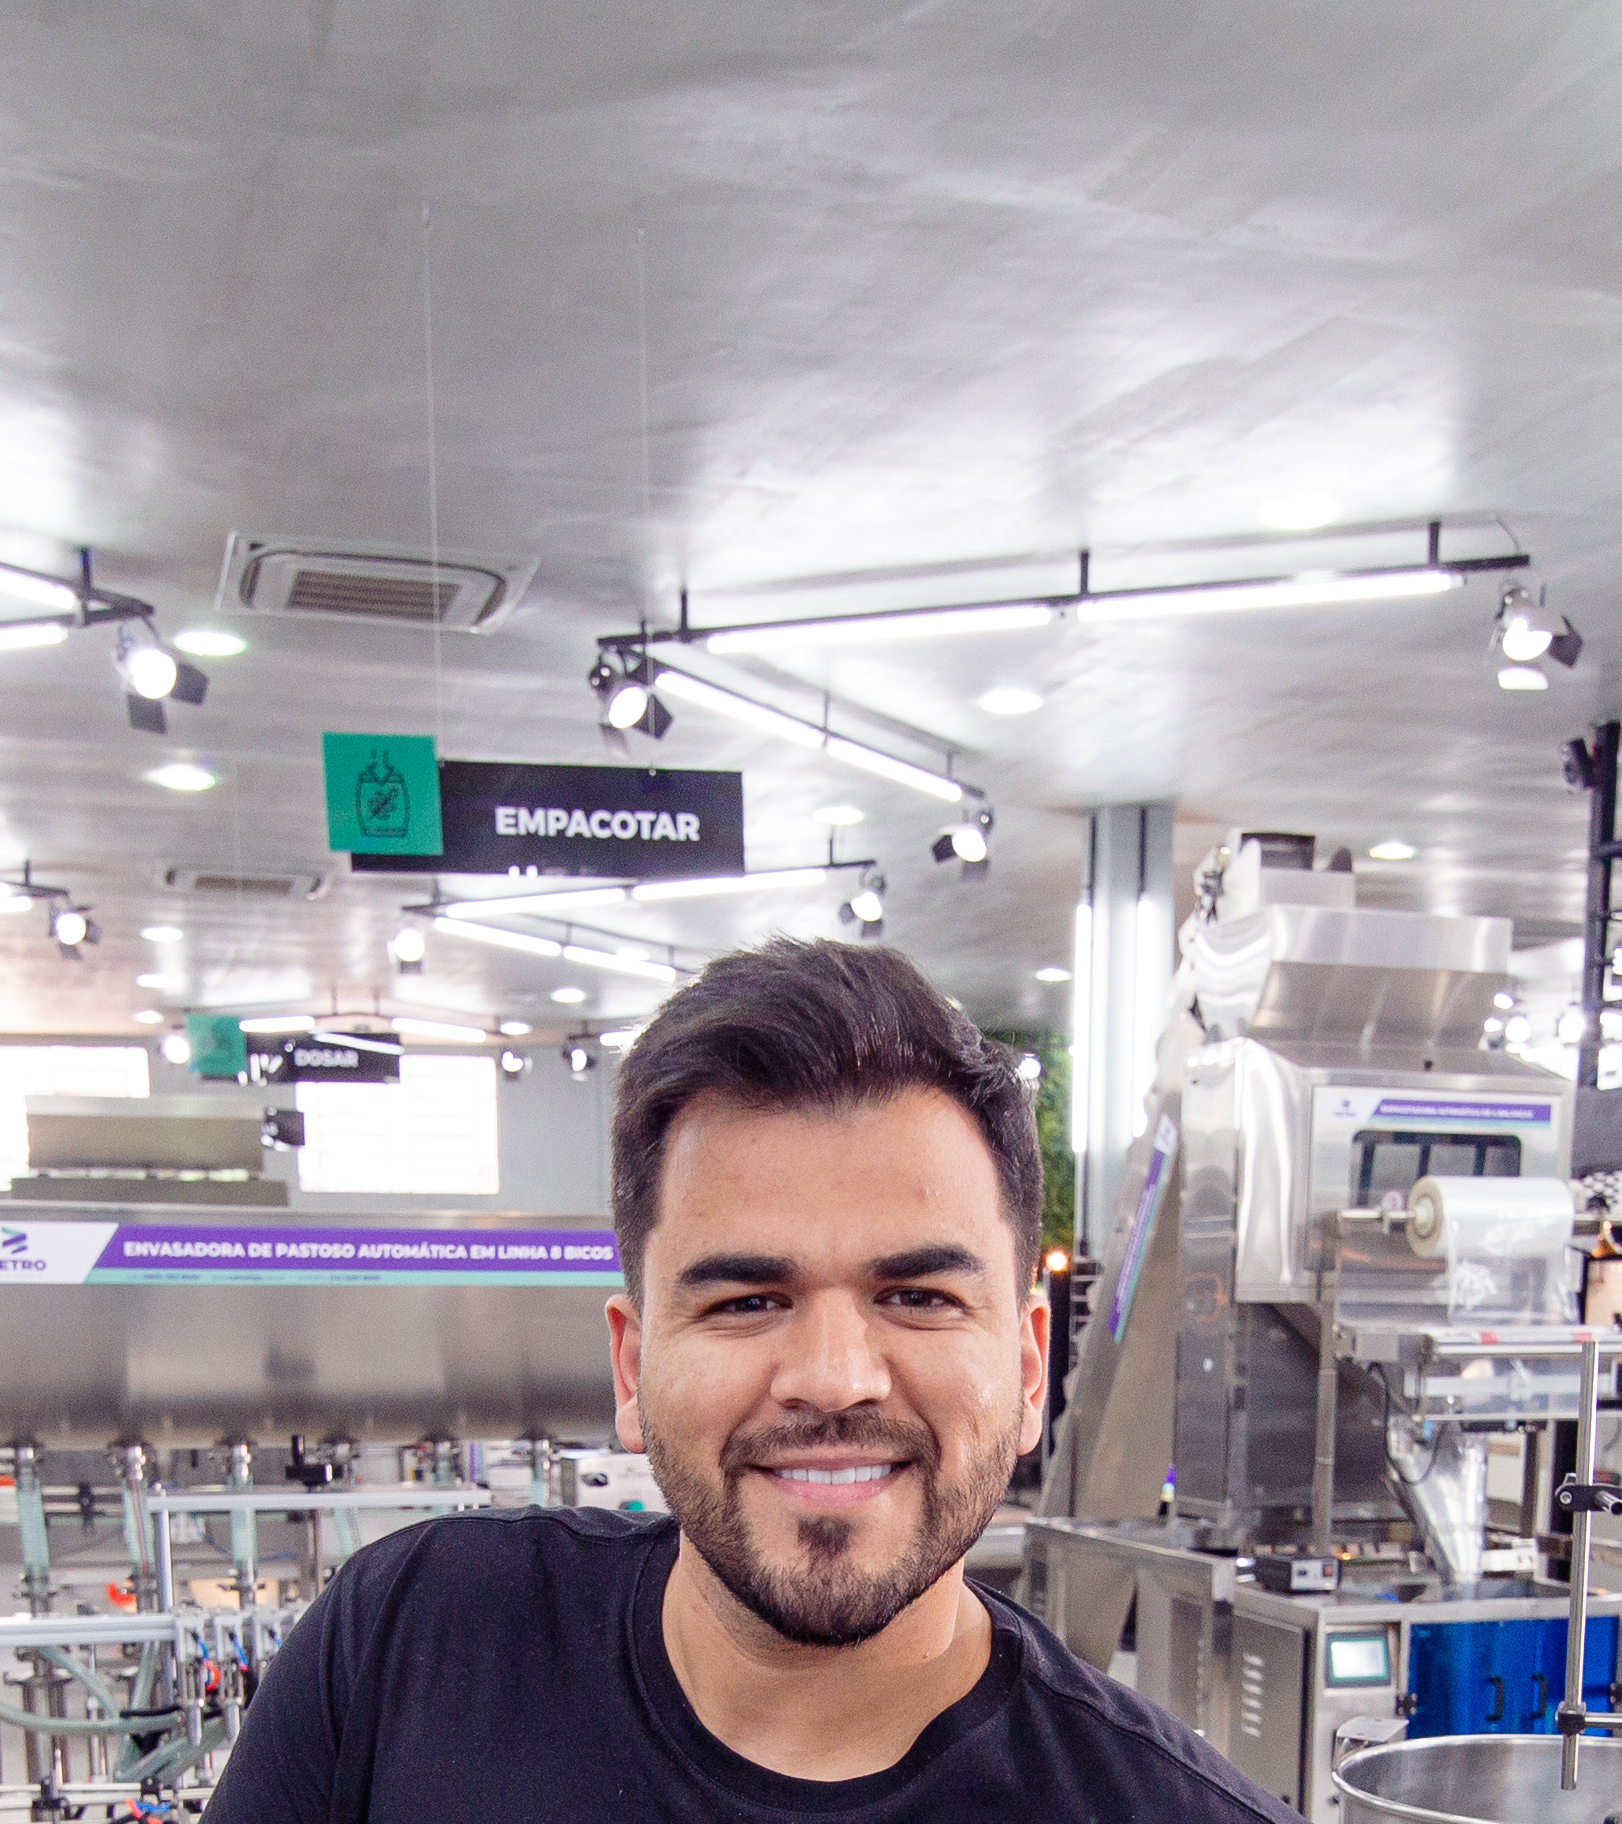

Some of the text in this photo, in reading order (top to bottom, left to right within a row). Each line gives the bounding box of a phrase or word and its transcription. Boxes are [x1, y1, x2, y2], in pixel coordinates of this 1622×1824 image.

[494, 806, 700, 842] EMPACOTAR
[294, 1048, 359, 1068] DOSAR
[123, 1241, 246, 1258] ENVASADORA
[248, 1242, 273, 1258] DE
[275, 1243, 355, 1259] PASTOSO
[357, 1240, 468, 1260] AUTOMÁTICA
[470, 1244, 495, 1260] EM
[498, 1244, 548, 1260] LINHA
[564, 1245, 614, 1261] BICOS
